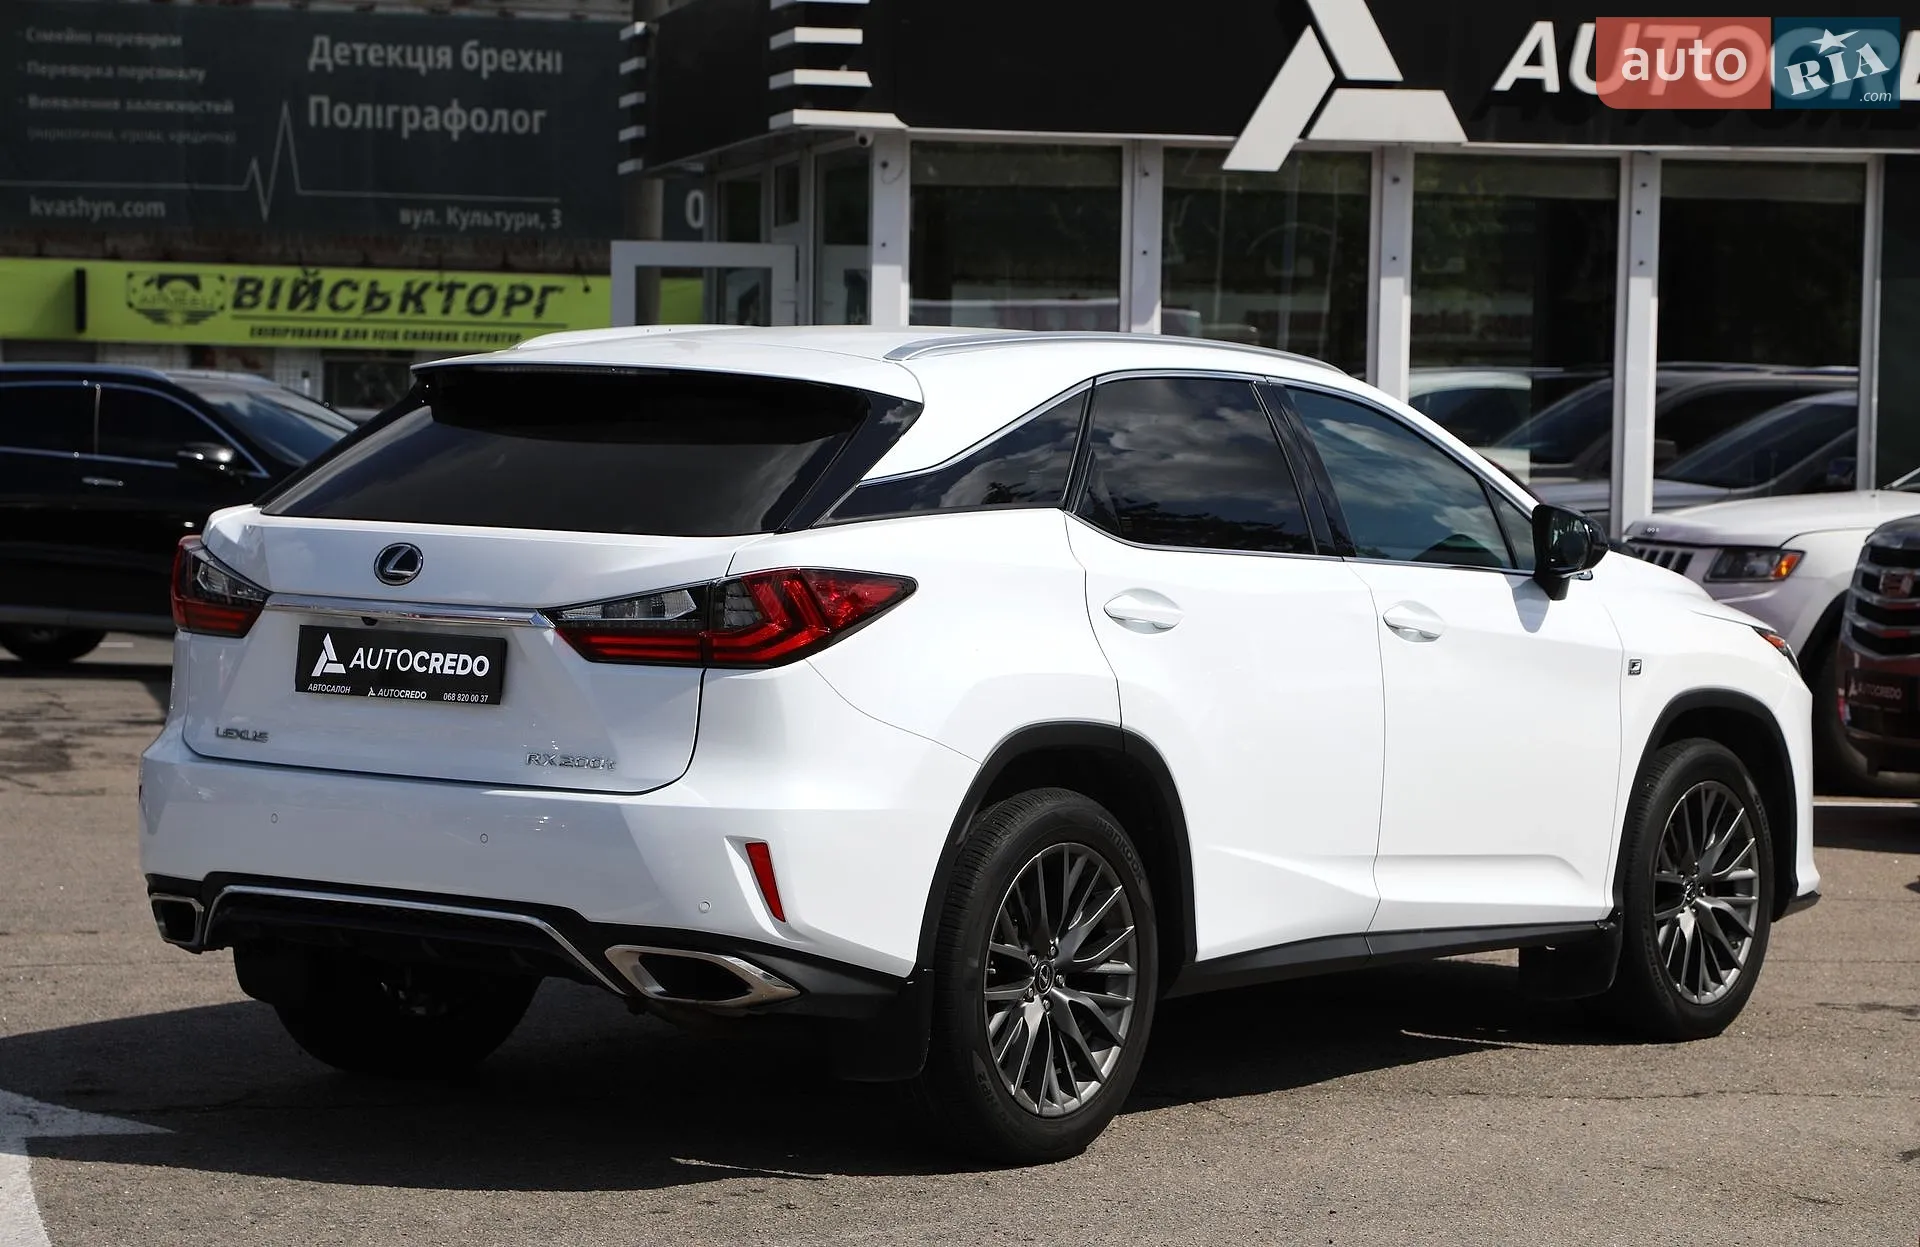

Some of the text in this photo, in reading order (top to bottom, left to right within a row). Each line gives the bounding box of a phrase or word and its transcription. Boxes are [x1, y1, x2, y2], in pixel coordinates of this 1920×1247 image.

[307, 33, 563, 80] Детекція брехні
[1491, 19, 1920, 101] AUTOCR
[308, 94, 548, 143] Поліграфолог
[29, 194, 166, 224] kvashyn.com
[399, 206, 563, 232] вул. Культури, 3
[233, 270, 566, 318] ВІЙСЬКТОРГ
[349, 647, 490, 677] AUTOCREDO
[307, 682, 351, 694] АВТОСАЛОН
[377, 688, 427, 700] AUTOCREDO
[443, 692, 489, 704] 068 820 00 37
[215, 726, 269, 744] LEXUS
[526, 752, 558, 767] RX
